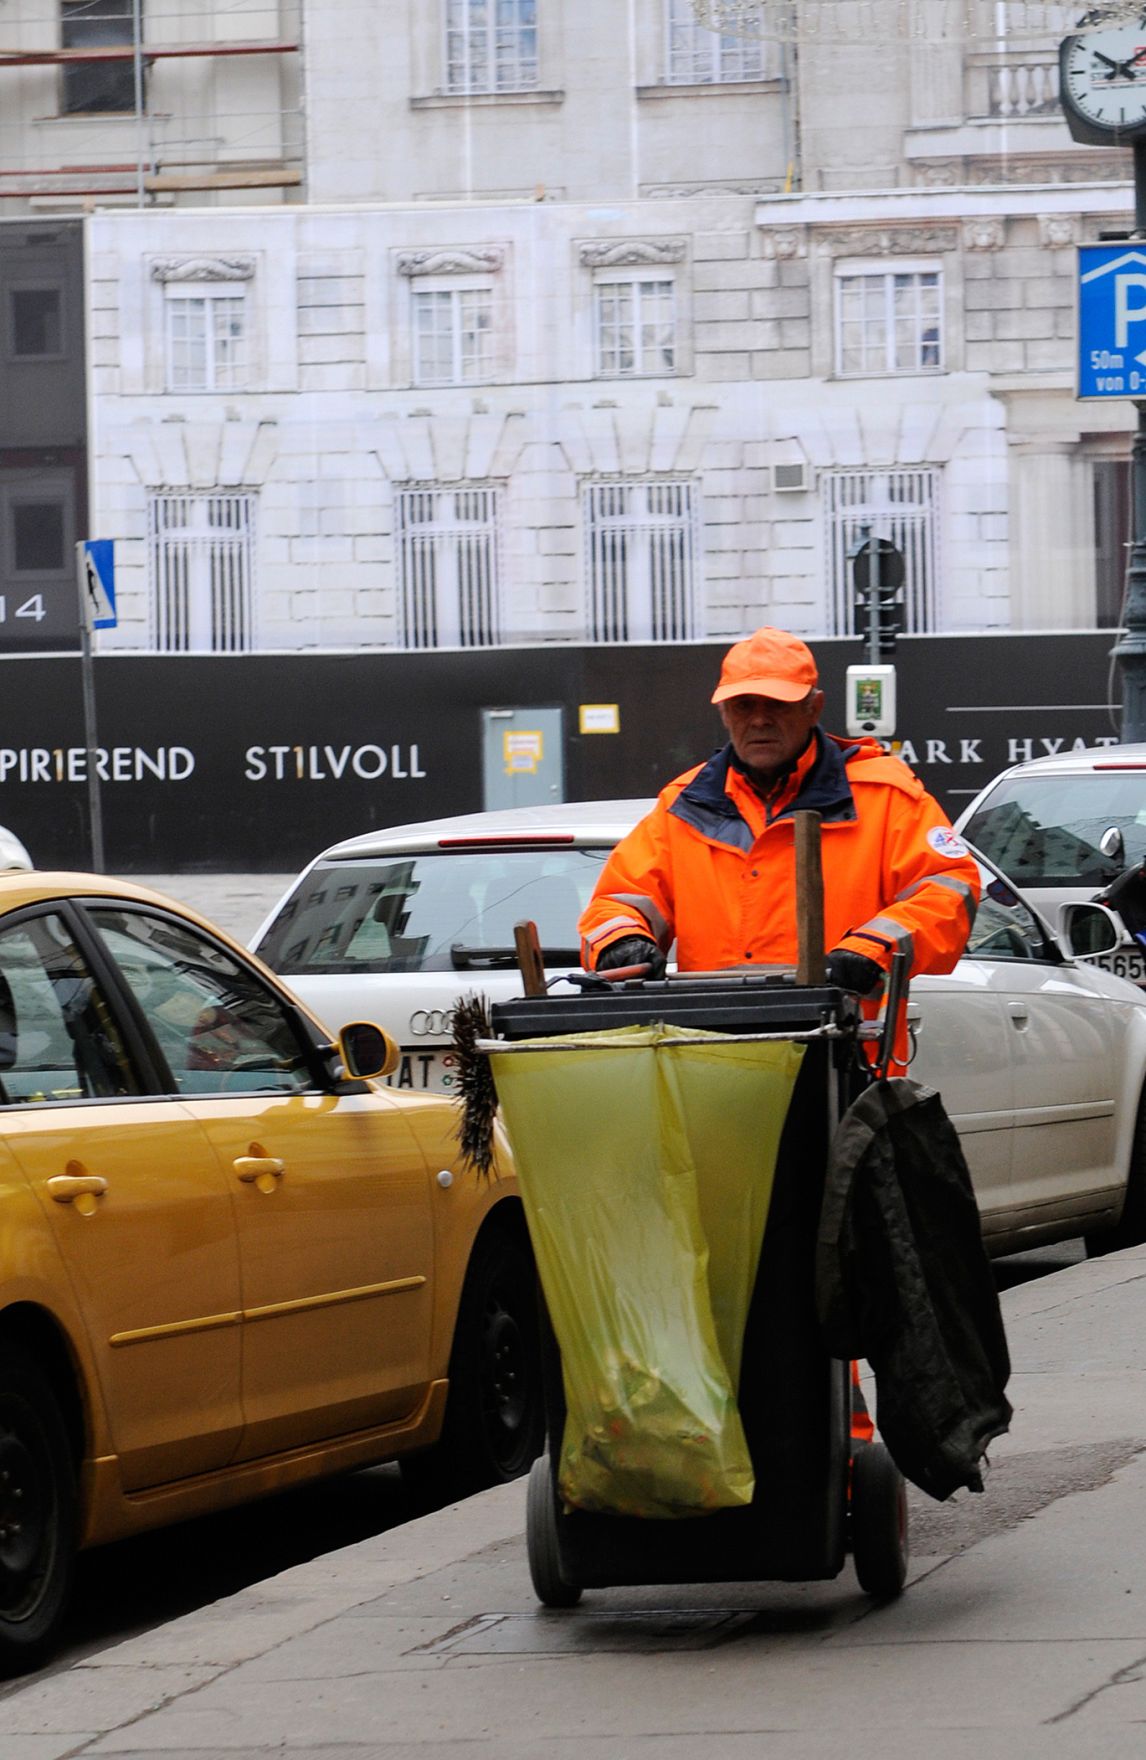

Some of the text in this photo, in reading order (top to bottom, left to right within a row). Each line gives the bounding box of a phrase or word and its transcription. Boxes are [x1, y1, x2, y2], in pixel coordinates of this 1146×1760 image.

[1115, 273, 1146, 348] P
[1090, 350, 1124, 369] 50m
[1096, 371, 1146, 391] von 0-
